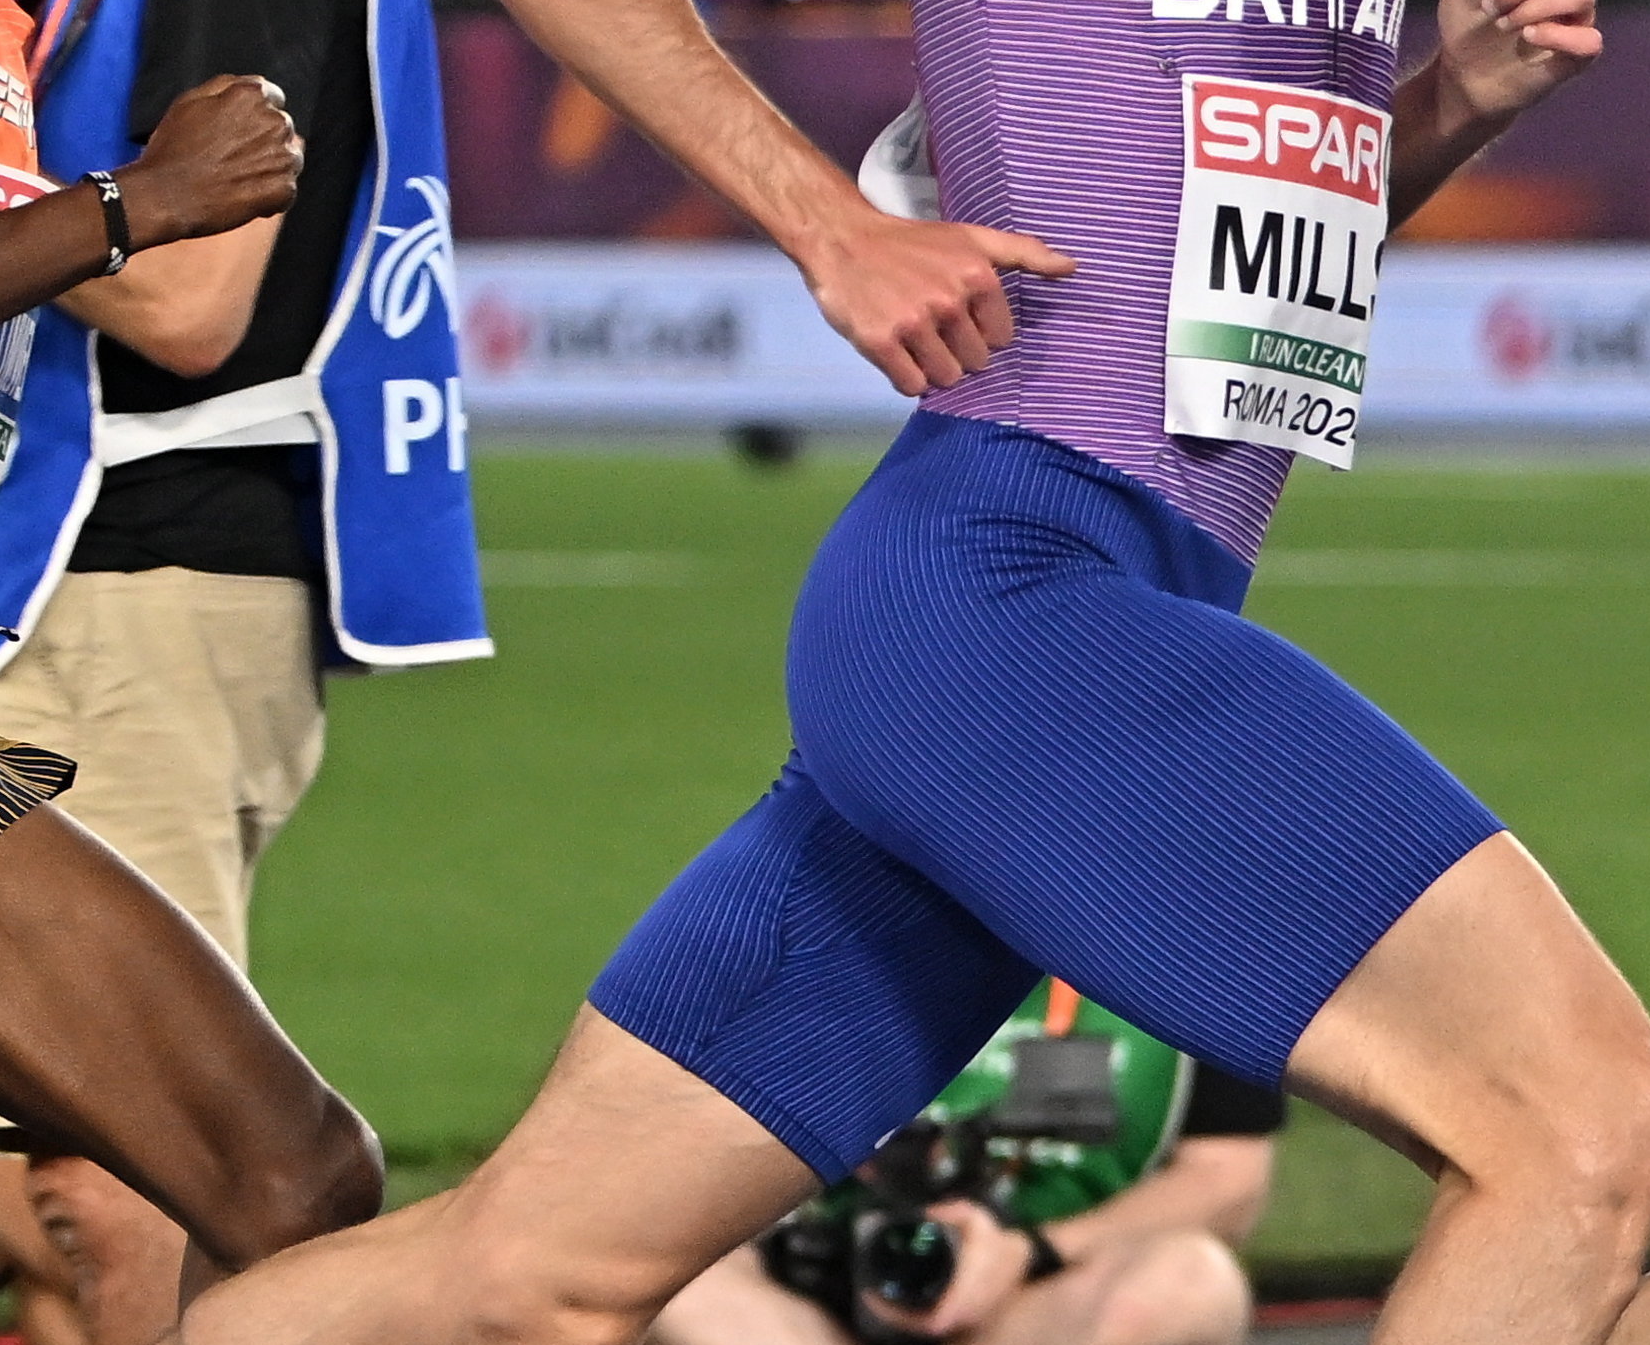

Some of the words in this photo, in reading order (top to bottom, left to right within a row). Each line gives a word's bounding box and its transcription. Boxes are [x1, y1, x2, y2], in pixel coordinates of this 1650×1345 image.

[1200, 95, 1379, 191] SPAR
[1293, 343, 1365, 388] CLEAN
[1223, 379, 1288, 428] ROMA
[1287, 393, 1356, 447] 202
